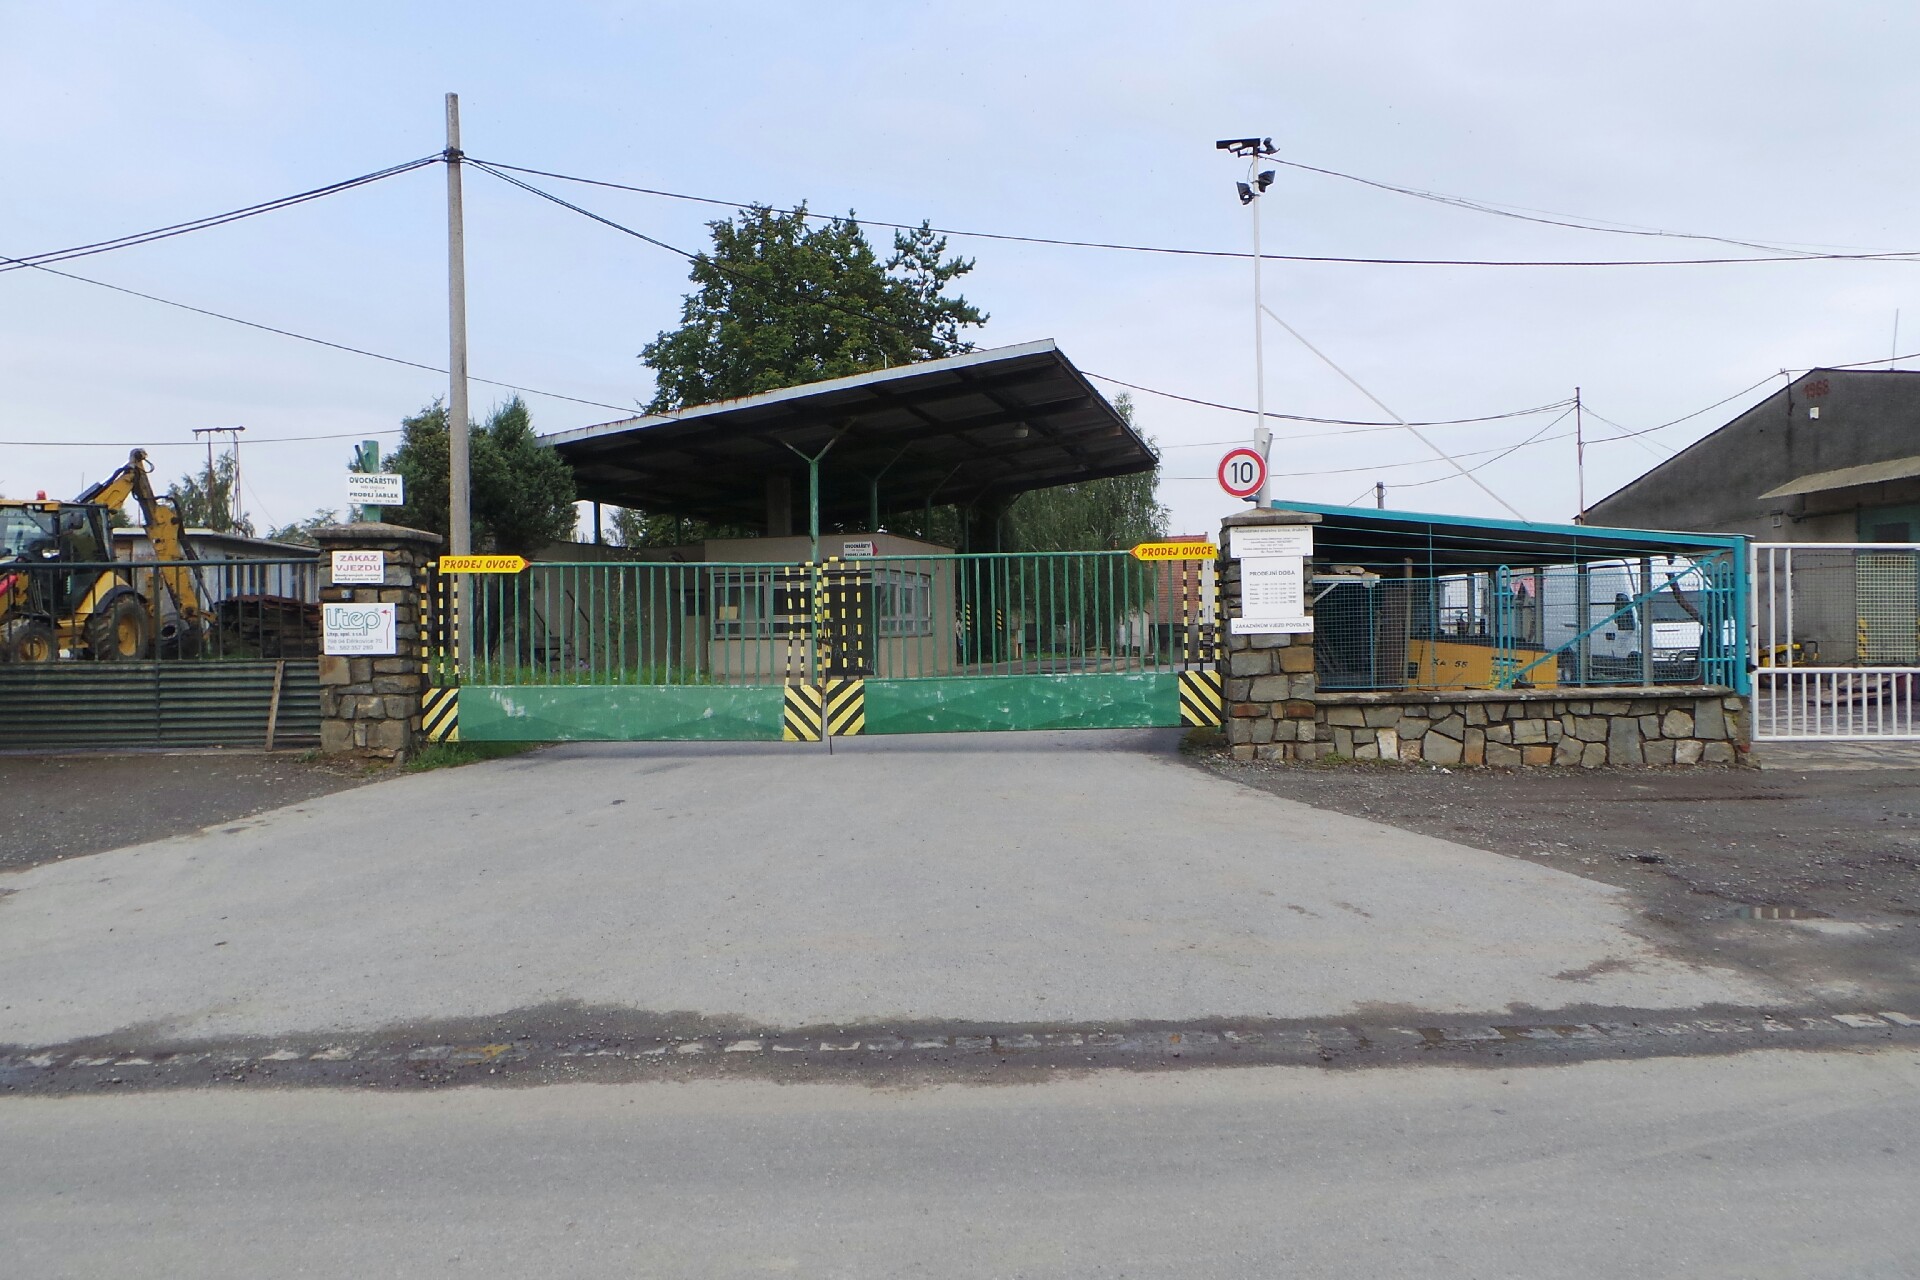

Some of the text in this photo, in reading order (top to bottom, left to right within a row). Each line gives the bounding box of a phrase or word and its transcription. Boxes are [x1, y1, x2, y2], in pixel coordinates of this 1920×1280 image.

[1231, 462, 1253, 483] 10
[1141, 546, 1213, 557] PRODEJ OVOCE
[340, 553, 377, 562] ZÁKAZ
[444, 560, 518, 569] PRODEJ OVOCE
